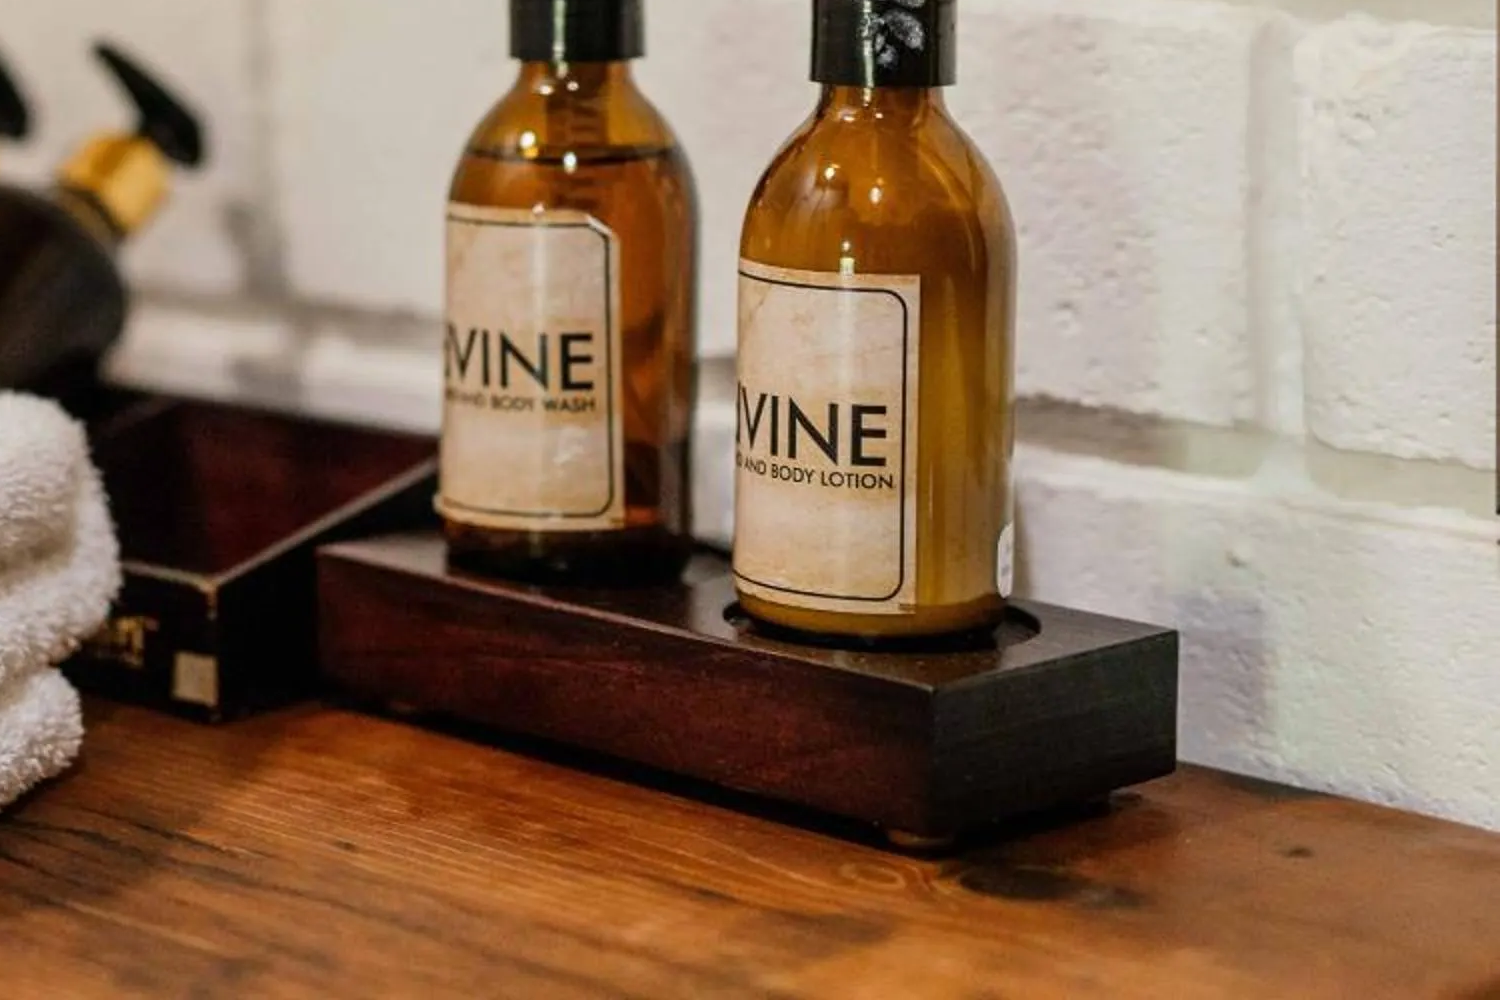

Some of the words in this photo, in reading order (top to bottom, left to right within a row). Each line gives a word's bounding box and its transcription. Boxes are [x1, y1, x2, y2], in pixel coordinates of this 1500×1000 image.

[491, 395, 534, 412] BODY
[544, 396, 595, 412] WASH
[744, 456, 767, 475] AND
[771, 463, 815, 484] BODY
[821, 470, 894, 489] LOTION
